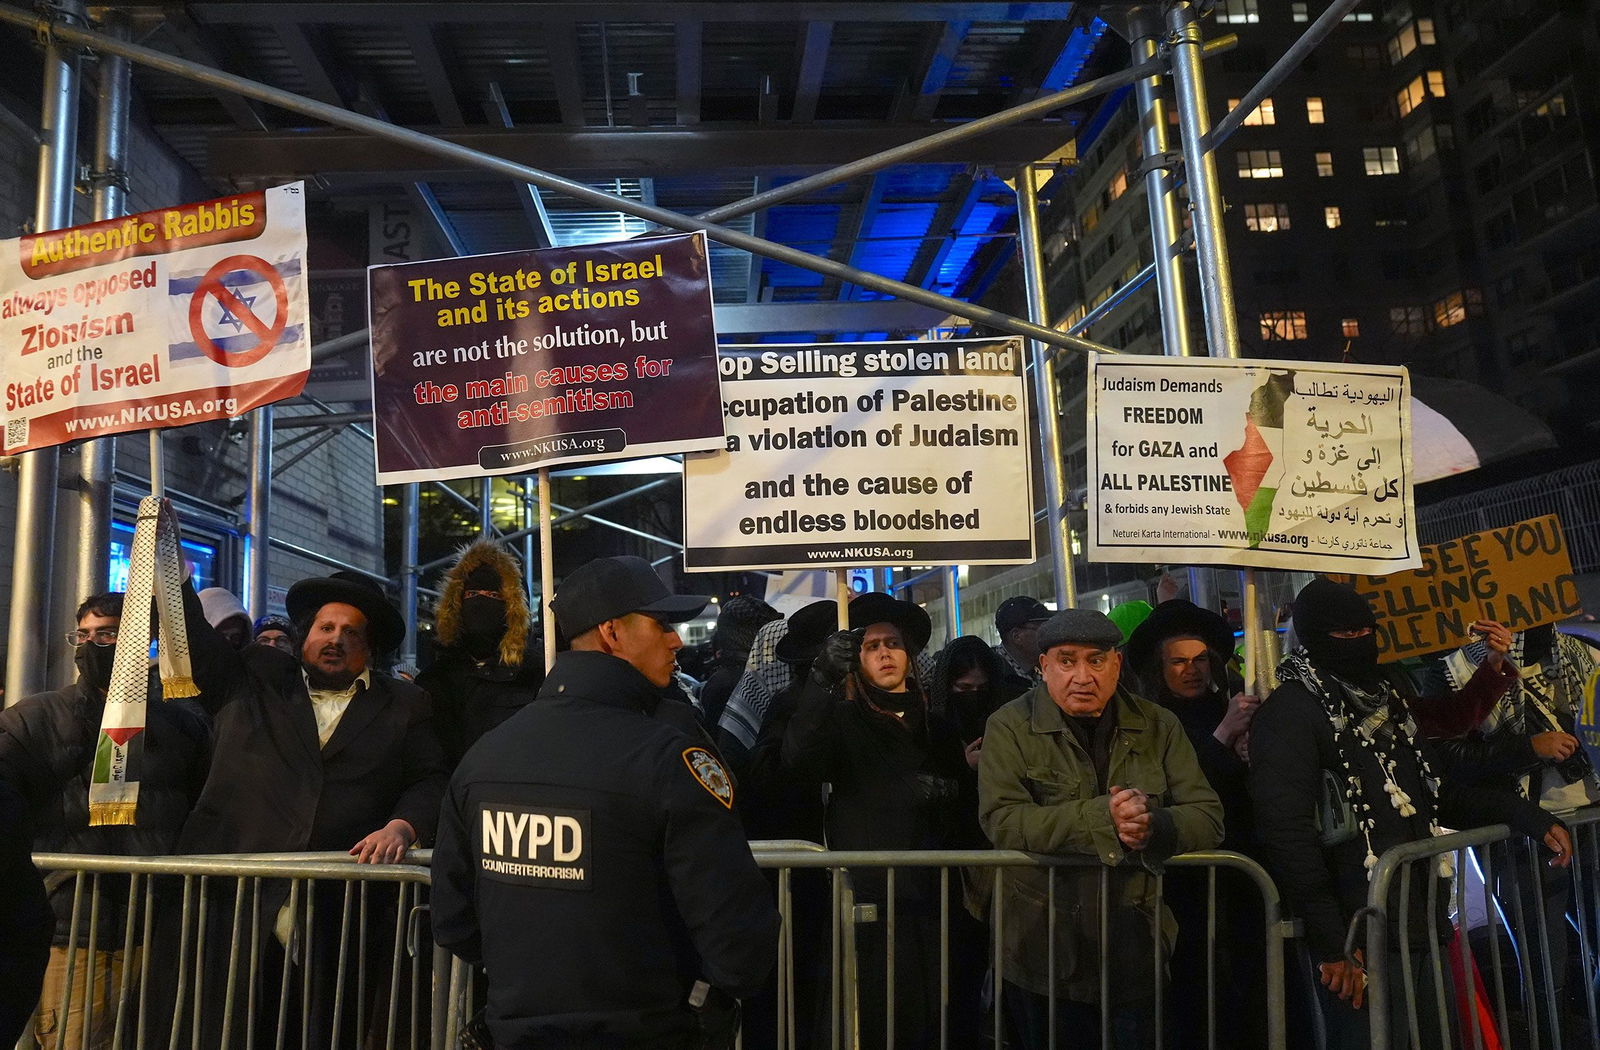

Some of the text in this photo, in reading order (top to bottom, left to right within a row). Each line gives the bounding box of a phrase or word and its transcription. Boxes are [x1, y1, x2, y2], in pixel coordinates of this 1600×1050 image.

[31, 199, 255, 266] Authentic Rabbis
[2, 261, 157, 320] always opposed
[408, 254, 663, 302] The State of Israel
[437, 286, 640, 328] and its actions
[20, 311, 135, 357] Zionism
[413, 319, 668, 368] are not the solution, but
[47, 345, 103, 370] and the
[760, 350, 857, 377] Selling
[864, 348, 949, 372] stolen
[957, 347, 1014, 372] land
[5, 354, 160, 412] State of Israel
[414, 355, 673, 405] the main causes for
[1102, 377, 1223, 393] Judaism Demands
[1295, 381, 1394, 406] اليهودية تطالب
[65, 396, 238, 433] www.NKUSA.org
[457, 388, 634, 430] anti-semitism
[857, 389, 884, 412] of
[892, 389, 1017, 412] Palestine
[1123, 407, 1203, 424] FREEDOM
[726, 423, 1018, 453] a violation of Judaism
[1306, 406, 1374, 440] الحرية
[500, 435, 605, 462] www.NKUSA.org
[1112, 440, 1218, 458] for GAZA and
[1319, 443, 1349, 466] غزة
[1357, 446, 1381, 471] إلى
[745, 470, 973, 499] and the cause of
[1101, 473, 1233, 492] ALL PALESTINE
[1291, 470, 1399, 503] كل فلسطين
[739, 508, 980, 535] endless bloodshed
[1104, 503, 1231, 517] & forbids any Jewish State
[808, 547, 914, 559] www.NKUSA.org
[1112, 529, 1140, 539] Neturei
[1141, 530, 1161, 539] Karta
[1162, 529, 1210, 540] International
[1218, 530, 1309, 547] www.nkusa.org
[1414, 521, 1562, 577] SEE YOU
[1485, 574, 1581, 628] LAND
[482, 809, 583, 862] NYPD
[482, 858, 584, 880] COUNTERTERRORISM
